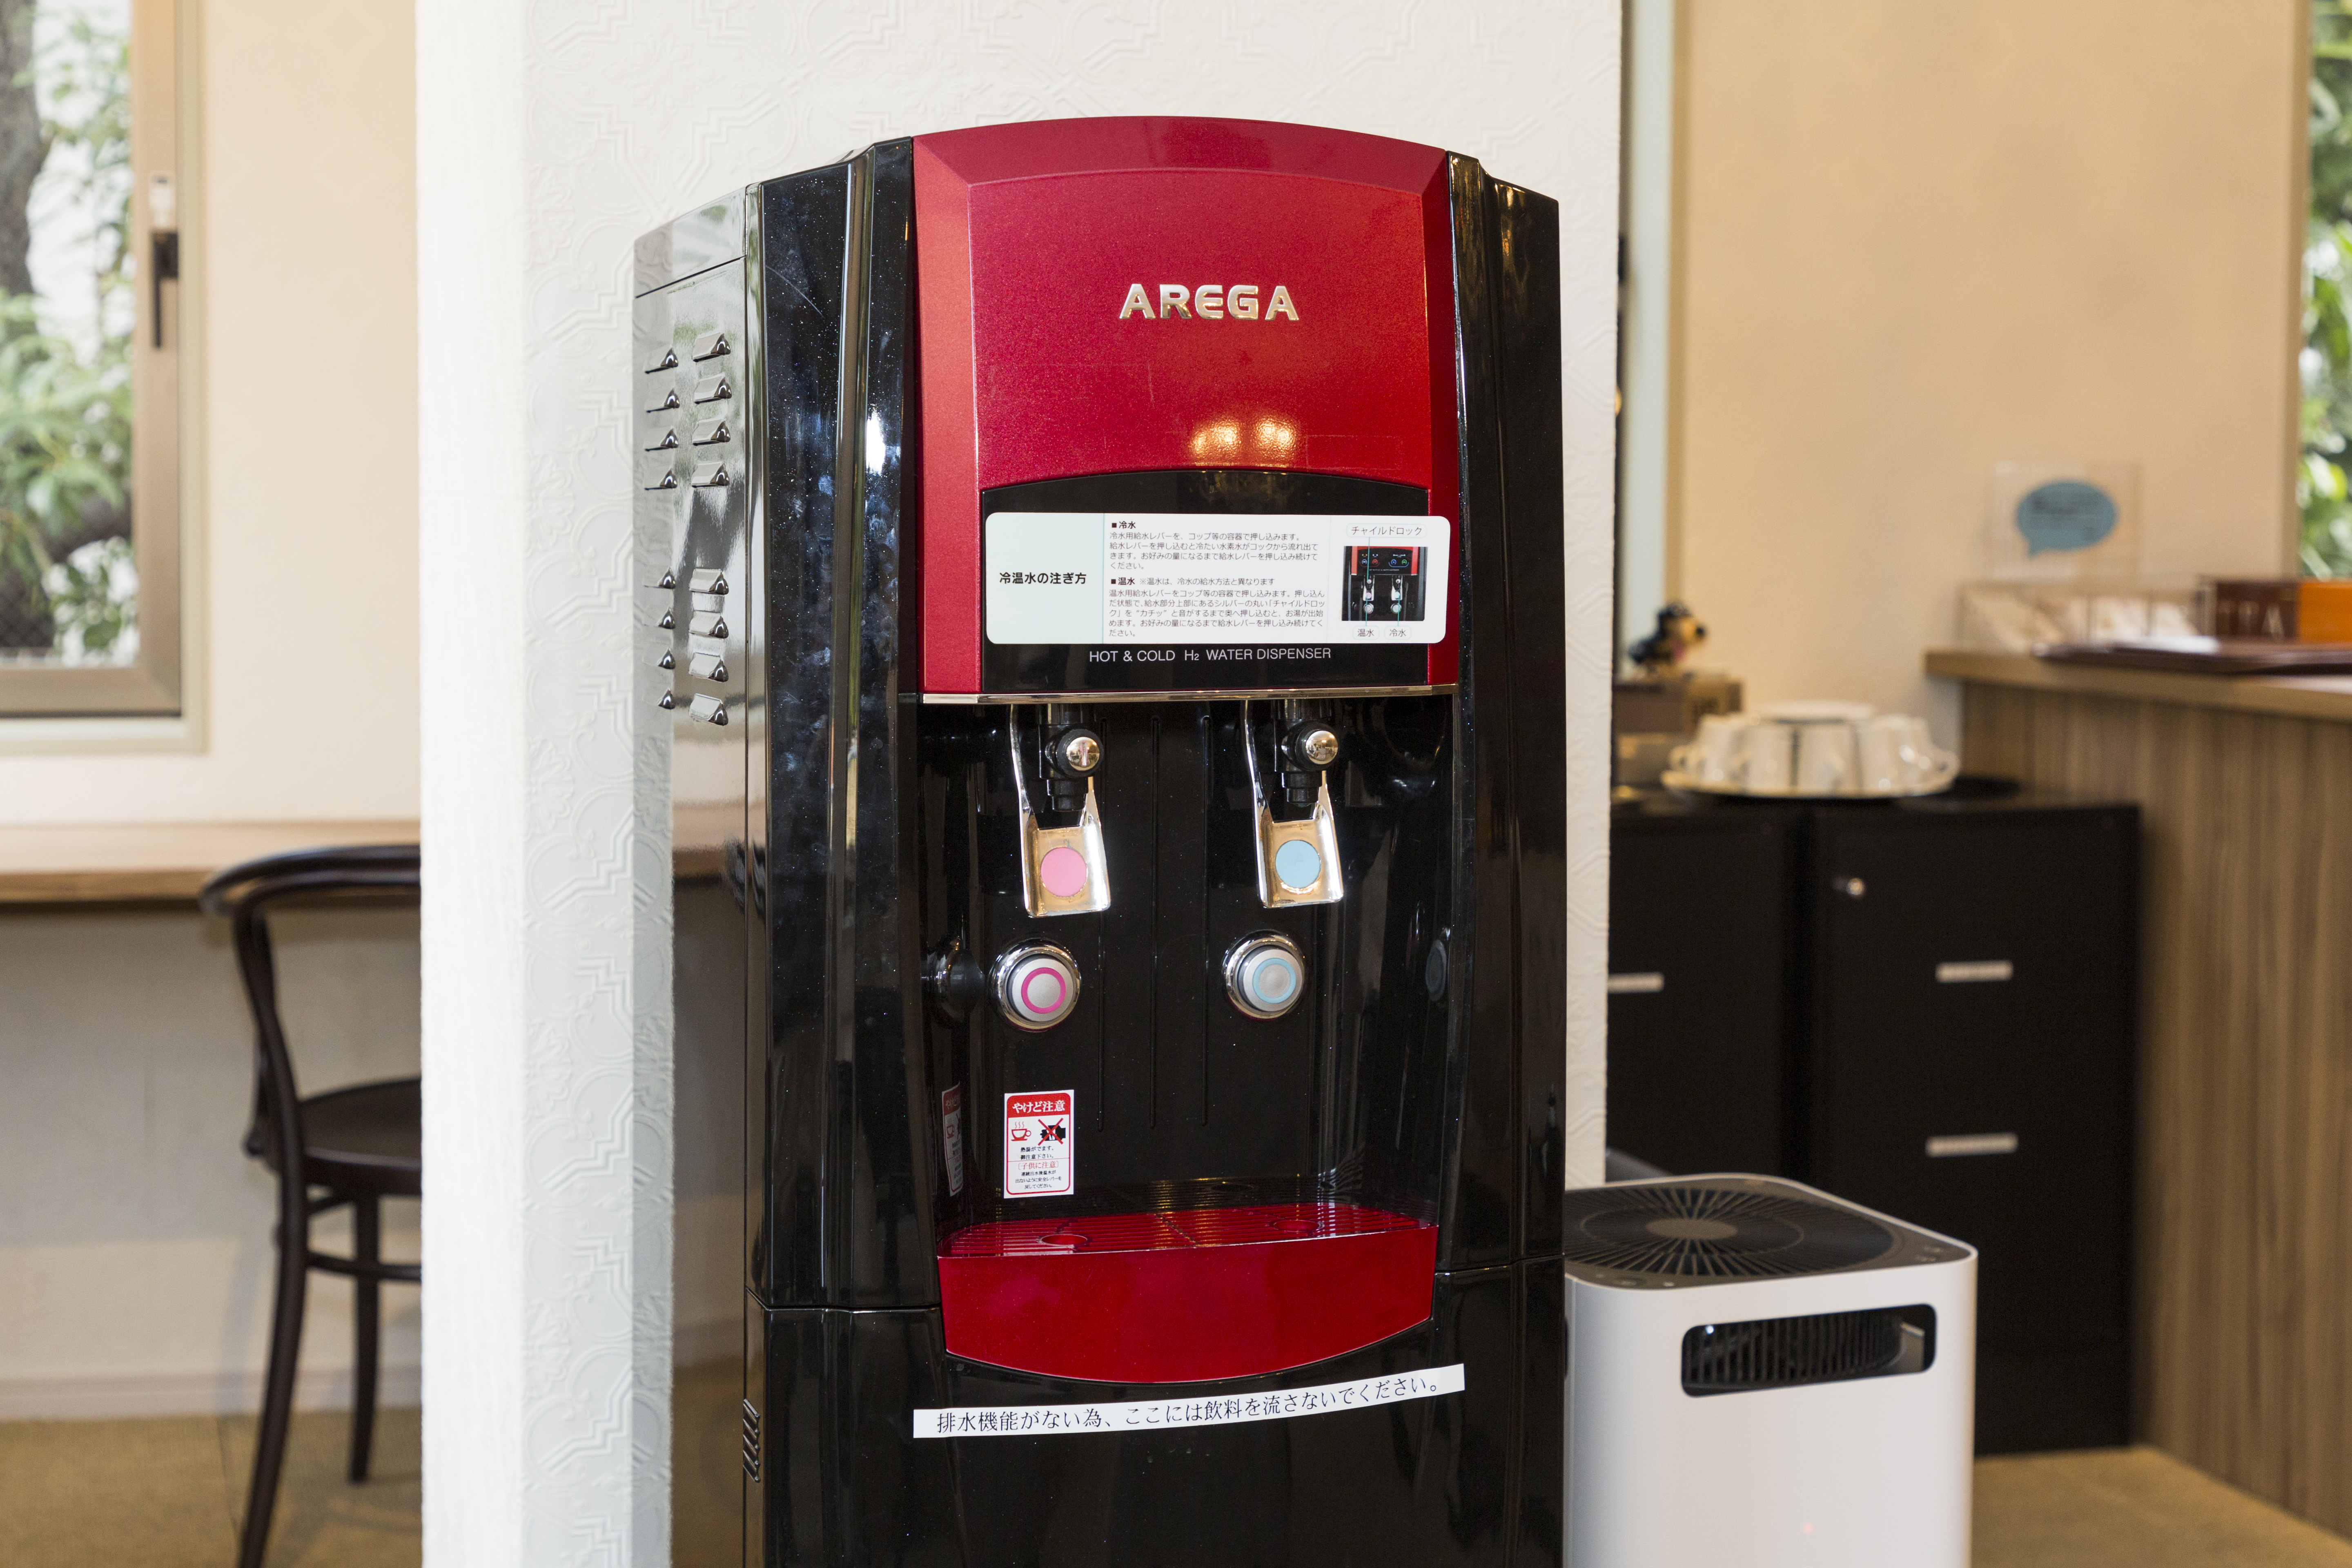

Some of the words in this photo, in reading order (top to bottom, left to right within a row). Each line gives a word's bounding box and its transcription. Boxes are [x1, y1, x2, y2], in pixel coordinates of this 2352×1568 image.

[1119, 283, 1299, 321] AREGA
[1119, 521, 1136, 529] 冷水
[1351, 526, 1422, 535] チャイルドロック
[999, 572, 1087, 584] 冷温水の注ぎ方
[1118, 577, 1136, 586] 温水
[1357, 628, 1374, 637] 温水
[1389, 628, 1406, 637] 冷水
[1090, 651, 1118, 662] HOT
[1123, 650, 1133, 662] &
[1137, 650, 1175, 662] COLD
[1206, 649, 1252, 660] WATER
[1257, 648, 1331, 659] DISPENSER
[1012, 1100, 1066, 1114] やけど注意
[937, 1377, 1437, 1434] 排水機能がない為、ここには飲料を流さないでください。
